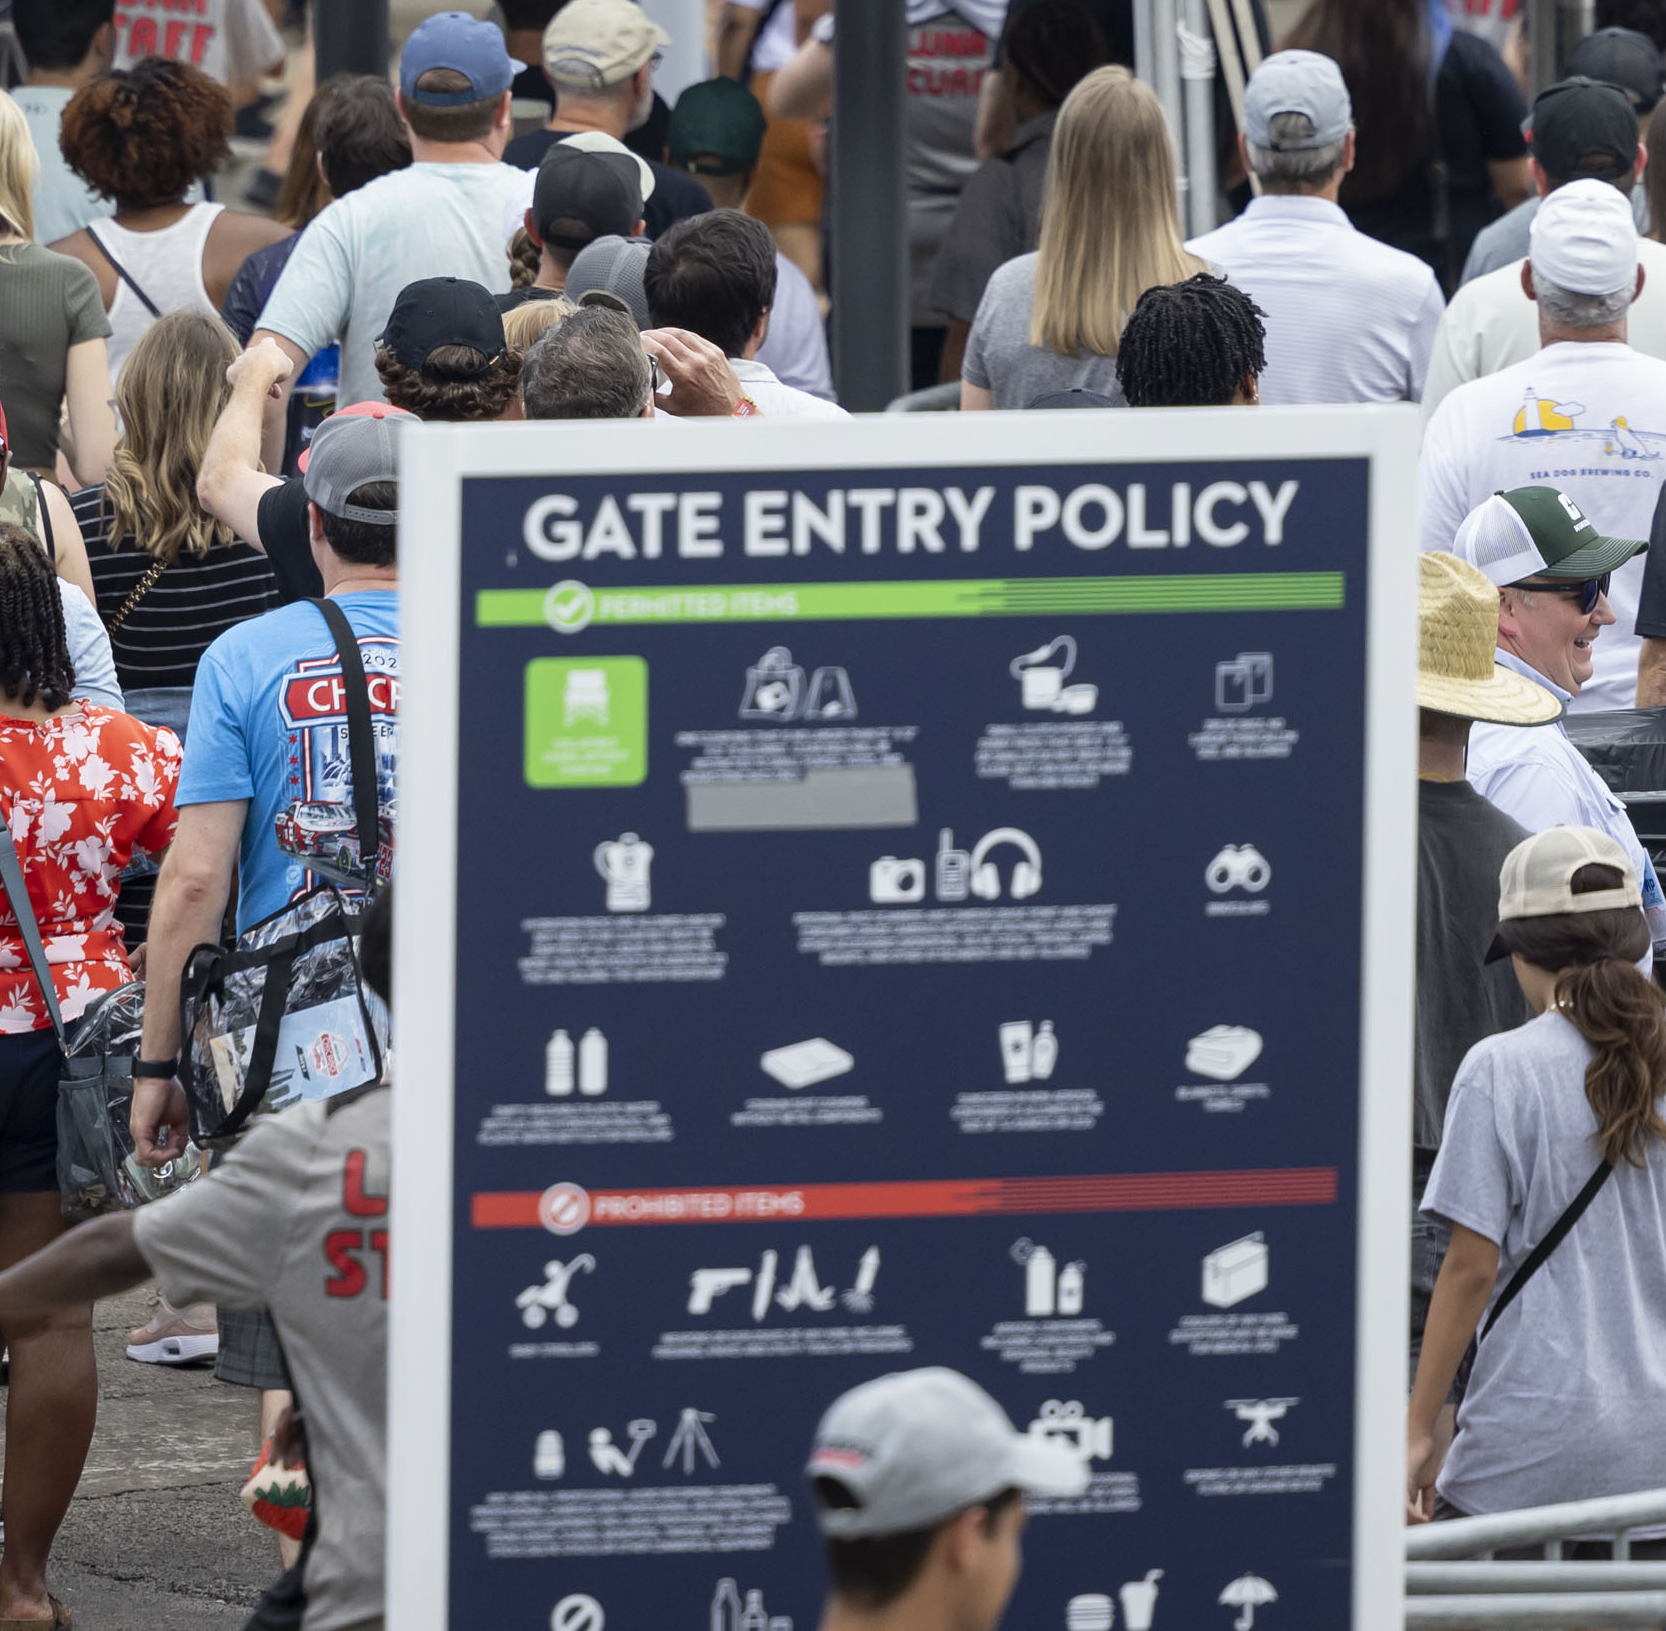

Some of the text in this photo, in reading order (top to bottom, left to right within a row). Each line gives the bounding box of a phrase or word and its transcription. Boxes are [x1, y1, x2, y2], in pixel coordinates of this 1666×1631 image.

[114, 14, 215, 65] TAFF
[1530, 469, 1654, 479] SEA DOG BREWING CO.
[522, 479, 1300, 562] GATE ENTRY POLICY
[599, 590, 799, 619] PERMITTED ITEMS
[362, 653, 398, 669] 202
[593, 1192, 805, 1221] PROHIBITED ITEMS
